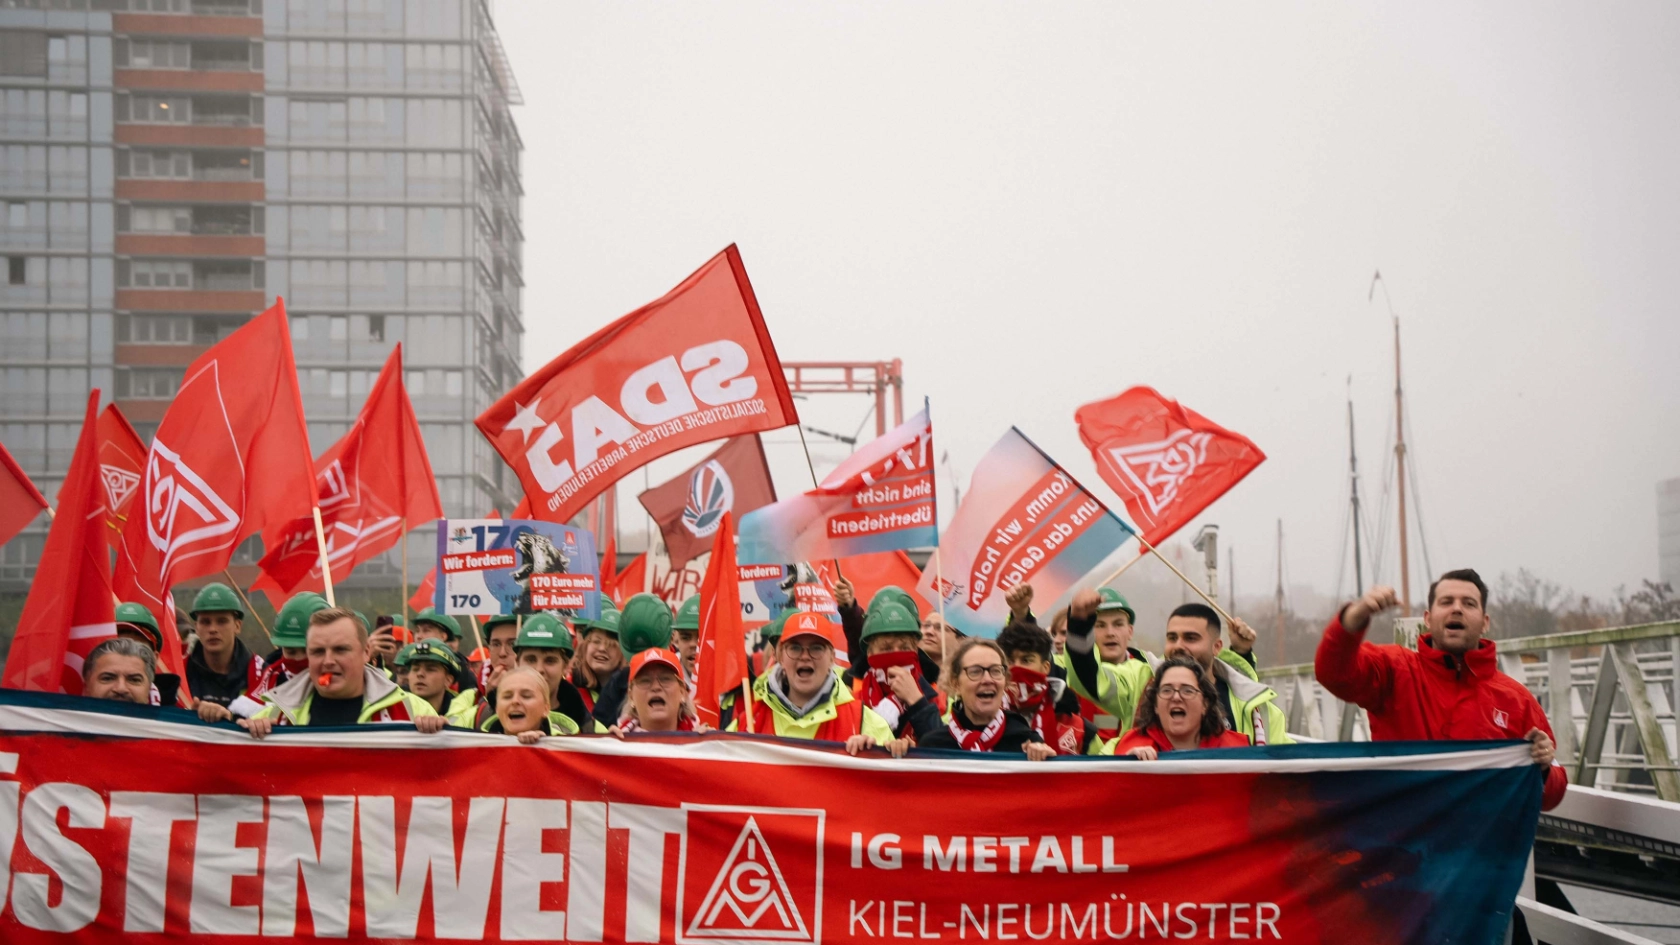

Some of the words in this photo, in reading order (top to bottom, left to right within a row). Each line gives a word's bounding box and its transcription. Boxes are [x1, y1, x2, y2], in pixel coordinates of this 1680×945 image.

[443, 555, 464, 571] Wir
[466, 554, 514, 569] fordern:
[741, 566, 780, 579] fordern:
[532, 576, 550, 588] 170
[552, 576, 572, 587] Euro
[573, 577, 594, 588] mehr
[796, 586, 811, 597] 170
[451, 594, 481, 608] 170
[533, 595, 548, 606] für
[551, 594, 583, 606] Azubis!
[0, 752, 687, 943] STENWEIT
[851, 832, 902, 871] IG
[922, 835, 1129, 874] METALL
[848, 893, 1282, 940] KIEL-NEUMÜNSTER
